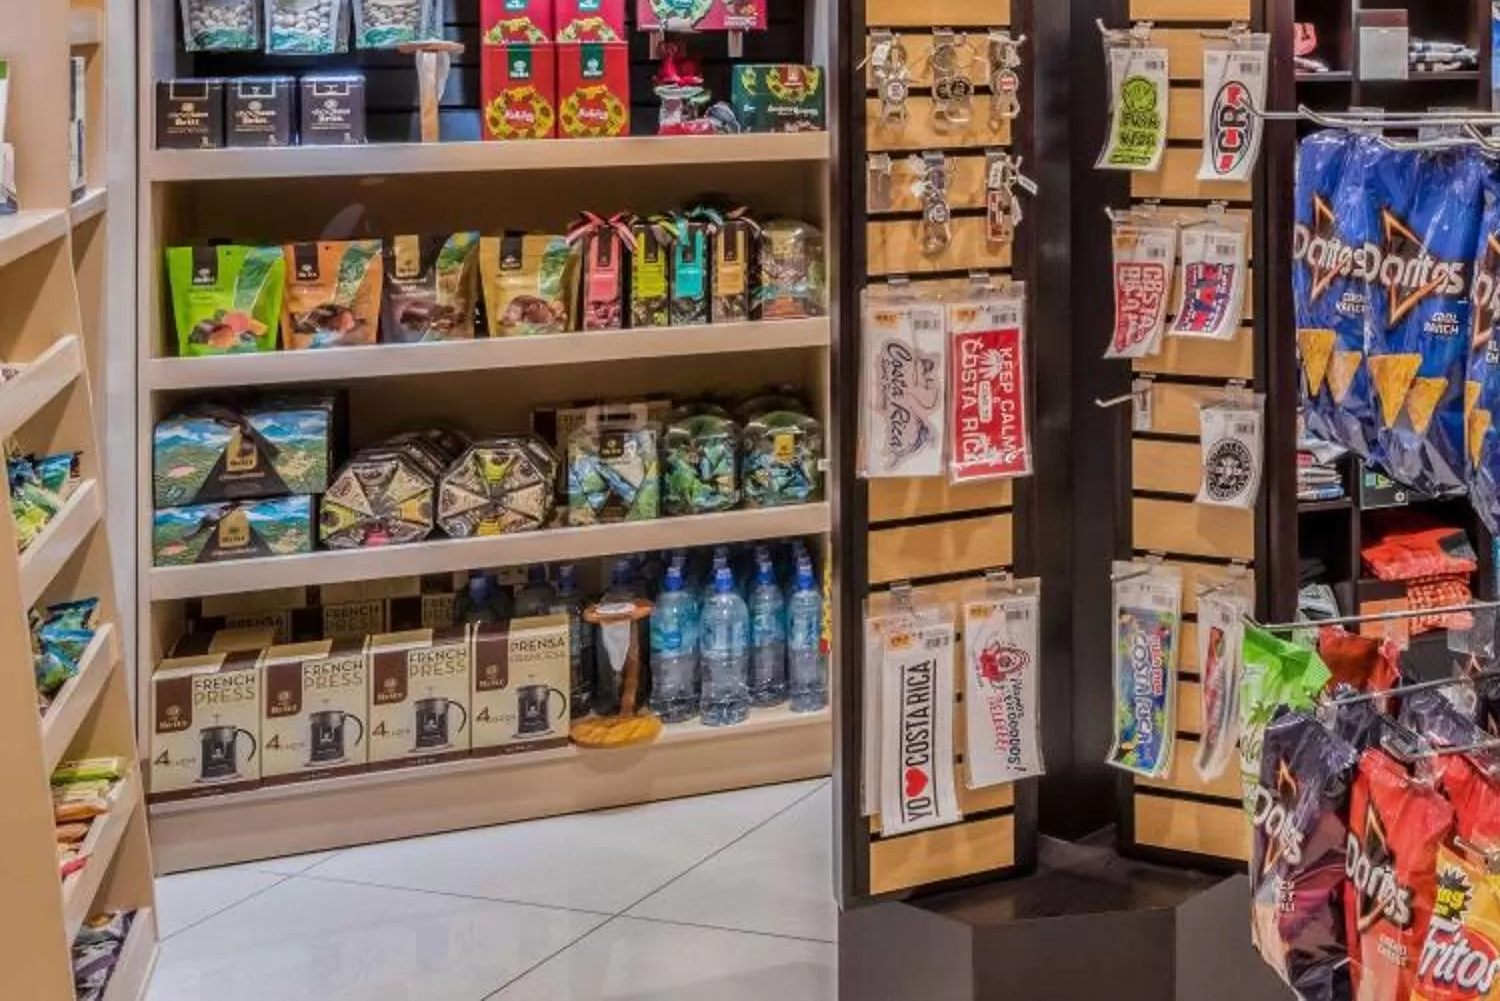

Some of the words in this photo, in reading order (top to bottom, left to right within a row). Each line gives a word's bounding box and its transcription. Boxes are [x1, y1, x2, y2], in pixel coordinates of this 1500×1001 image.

[1363, 240, 1465, 296] Doritos
[1432, 312, 1460, 324] COOL
[1423, 322, 1461, 336] RANCH
[961, 337, 984, 409] COSTA
[999, 346, 1018, 394] KEEP
[510, 636, 566, 652] PRENSA
[409, 648, 466, 664] FRENCH
[304, 659, 364, 676] FRENCH
[409, 660, 466, 678] PRESS
[195, 674, 256, 691] FRENCH
[304, 672, 363, 689] PRESS
[907, 659, 933, 705] RICA
[194, 686, 256, 706] PRESS
[476, 706, 492, 723] 4
[371, 719, 386, 737] 4
[264, 734, 281, 750] 4
[905, 709, 932, 768] COSTA
[153, 749, 170, 767] 4
[906, 795, 934, 823] YO
[1437, 888, 1466, 910] ing
